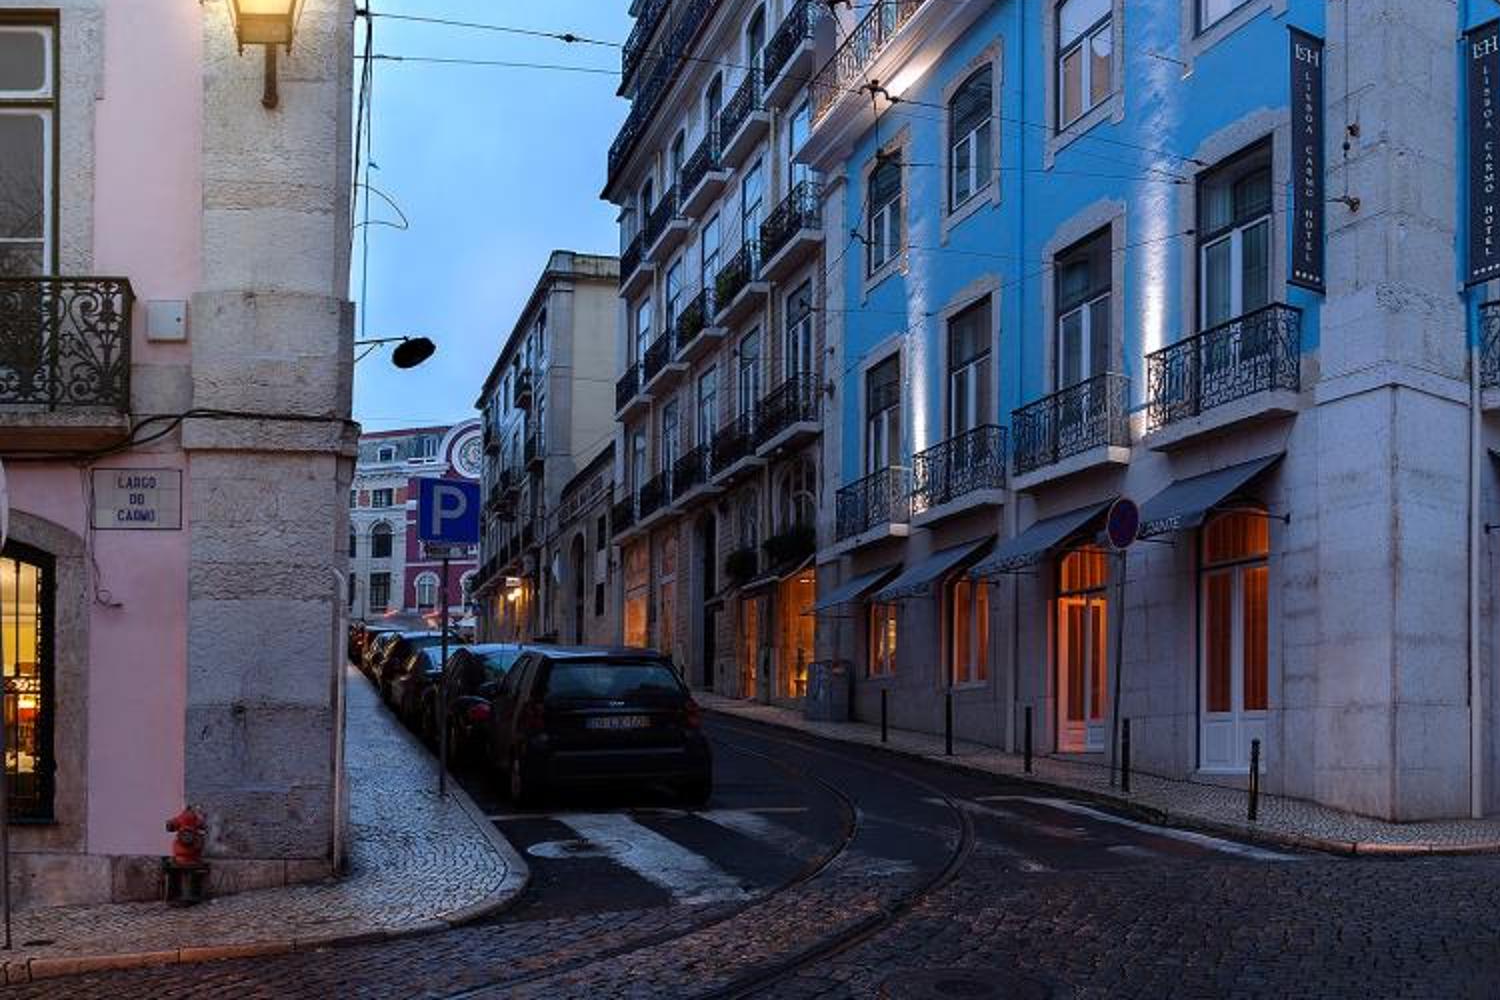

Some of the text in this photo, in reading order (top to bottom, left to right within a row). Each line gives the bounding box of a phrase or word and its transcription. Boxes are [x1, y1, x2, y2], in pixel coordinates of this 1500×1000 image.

[1482, 65, 1494, 256] LISBOA CARMO HOTEL
[1305, 209, 1313, 261] HOTEL
[117, 476, 157, 489] LARGO
[129, 493, 145, 505] DO
[432, 485, 467, 536] P
[117, 509, 155, 522] CARMO
